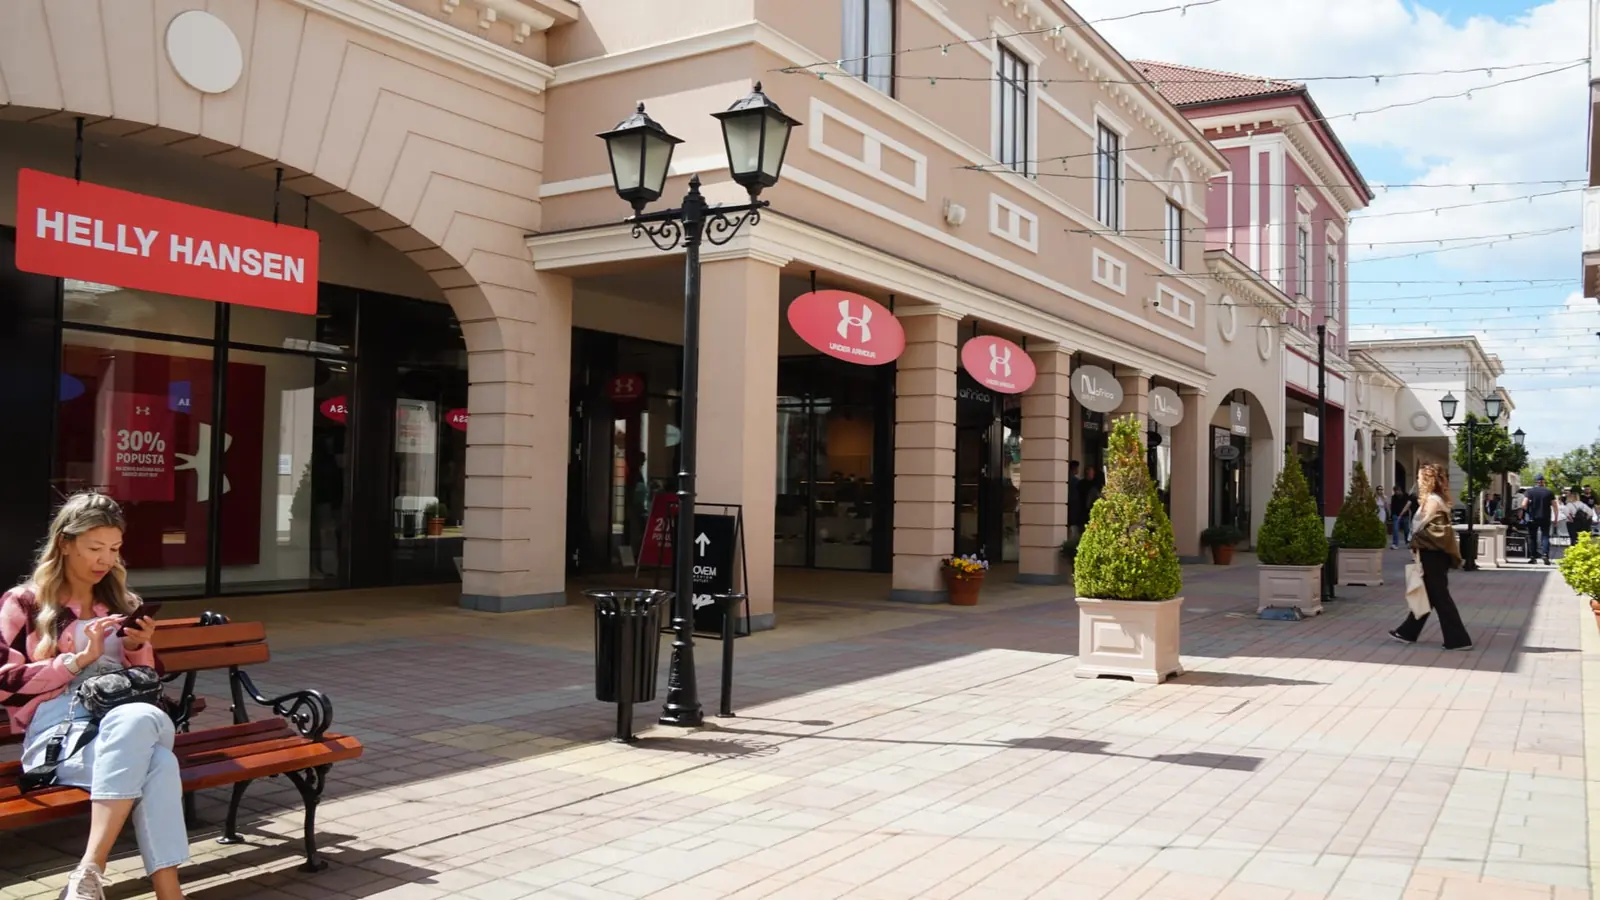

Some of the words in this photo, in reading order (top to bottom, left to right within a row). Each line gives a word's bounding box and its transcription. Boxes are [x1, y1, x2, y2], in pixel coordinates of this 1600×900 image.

[36, 207, 159, 257] HELLY
[169, 234, 304, 283] HANSEN
[829, 342, 850, 353] UNDER
[116, 429, 165, 452] 30%
[116, 452, 165, 465] POPUSTA
[692, 565, 717, 576] OVEM
